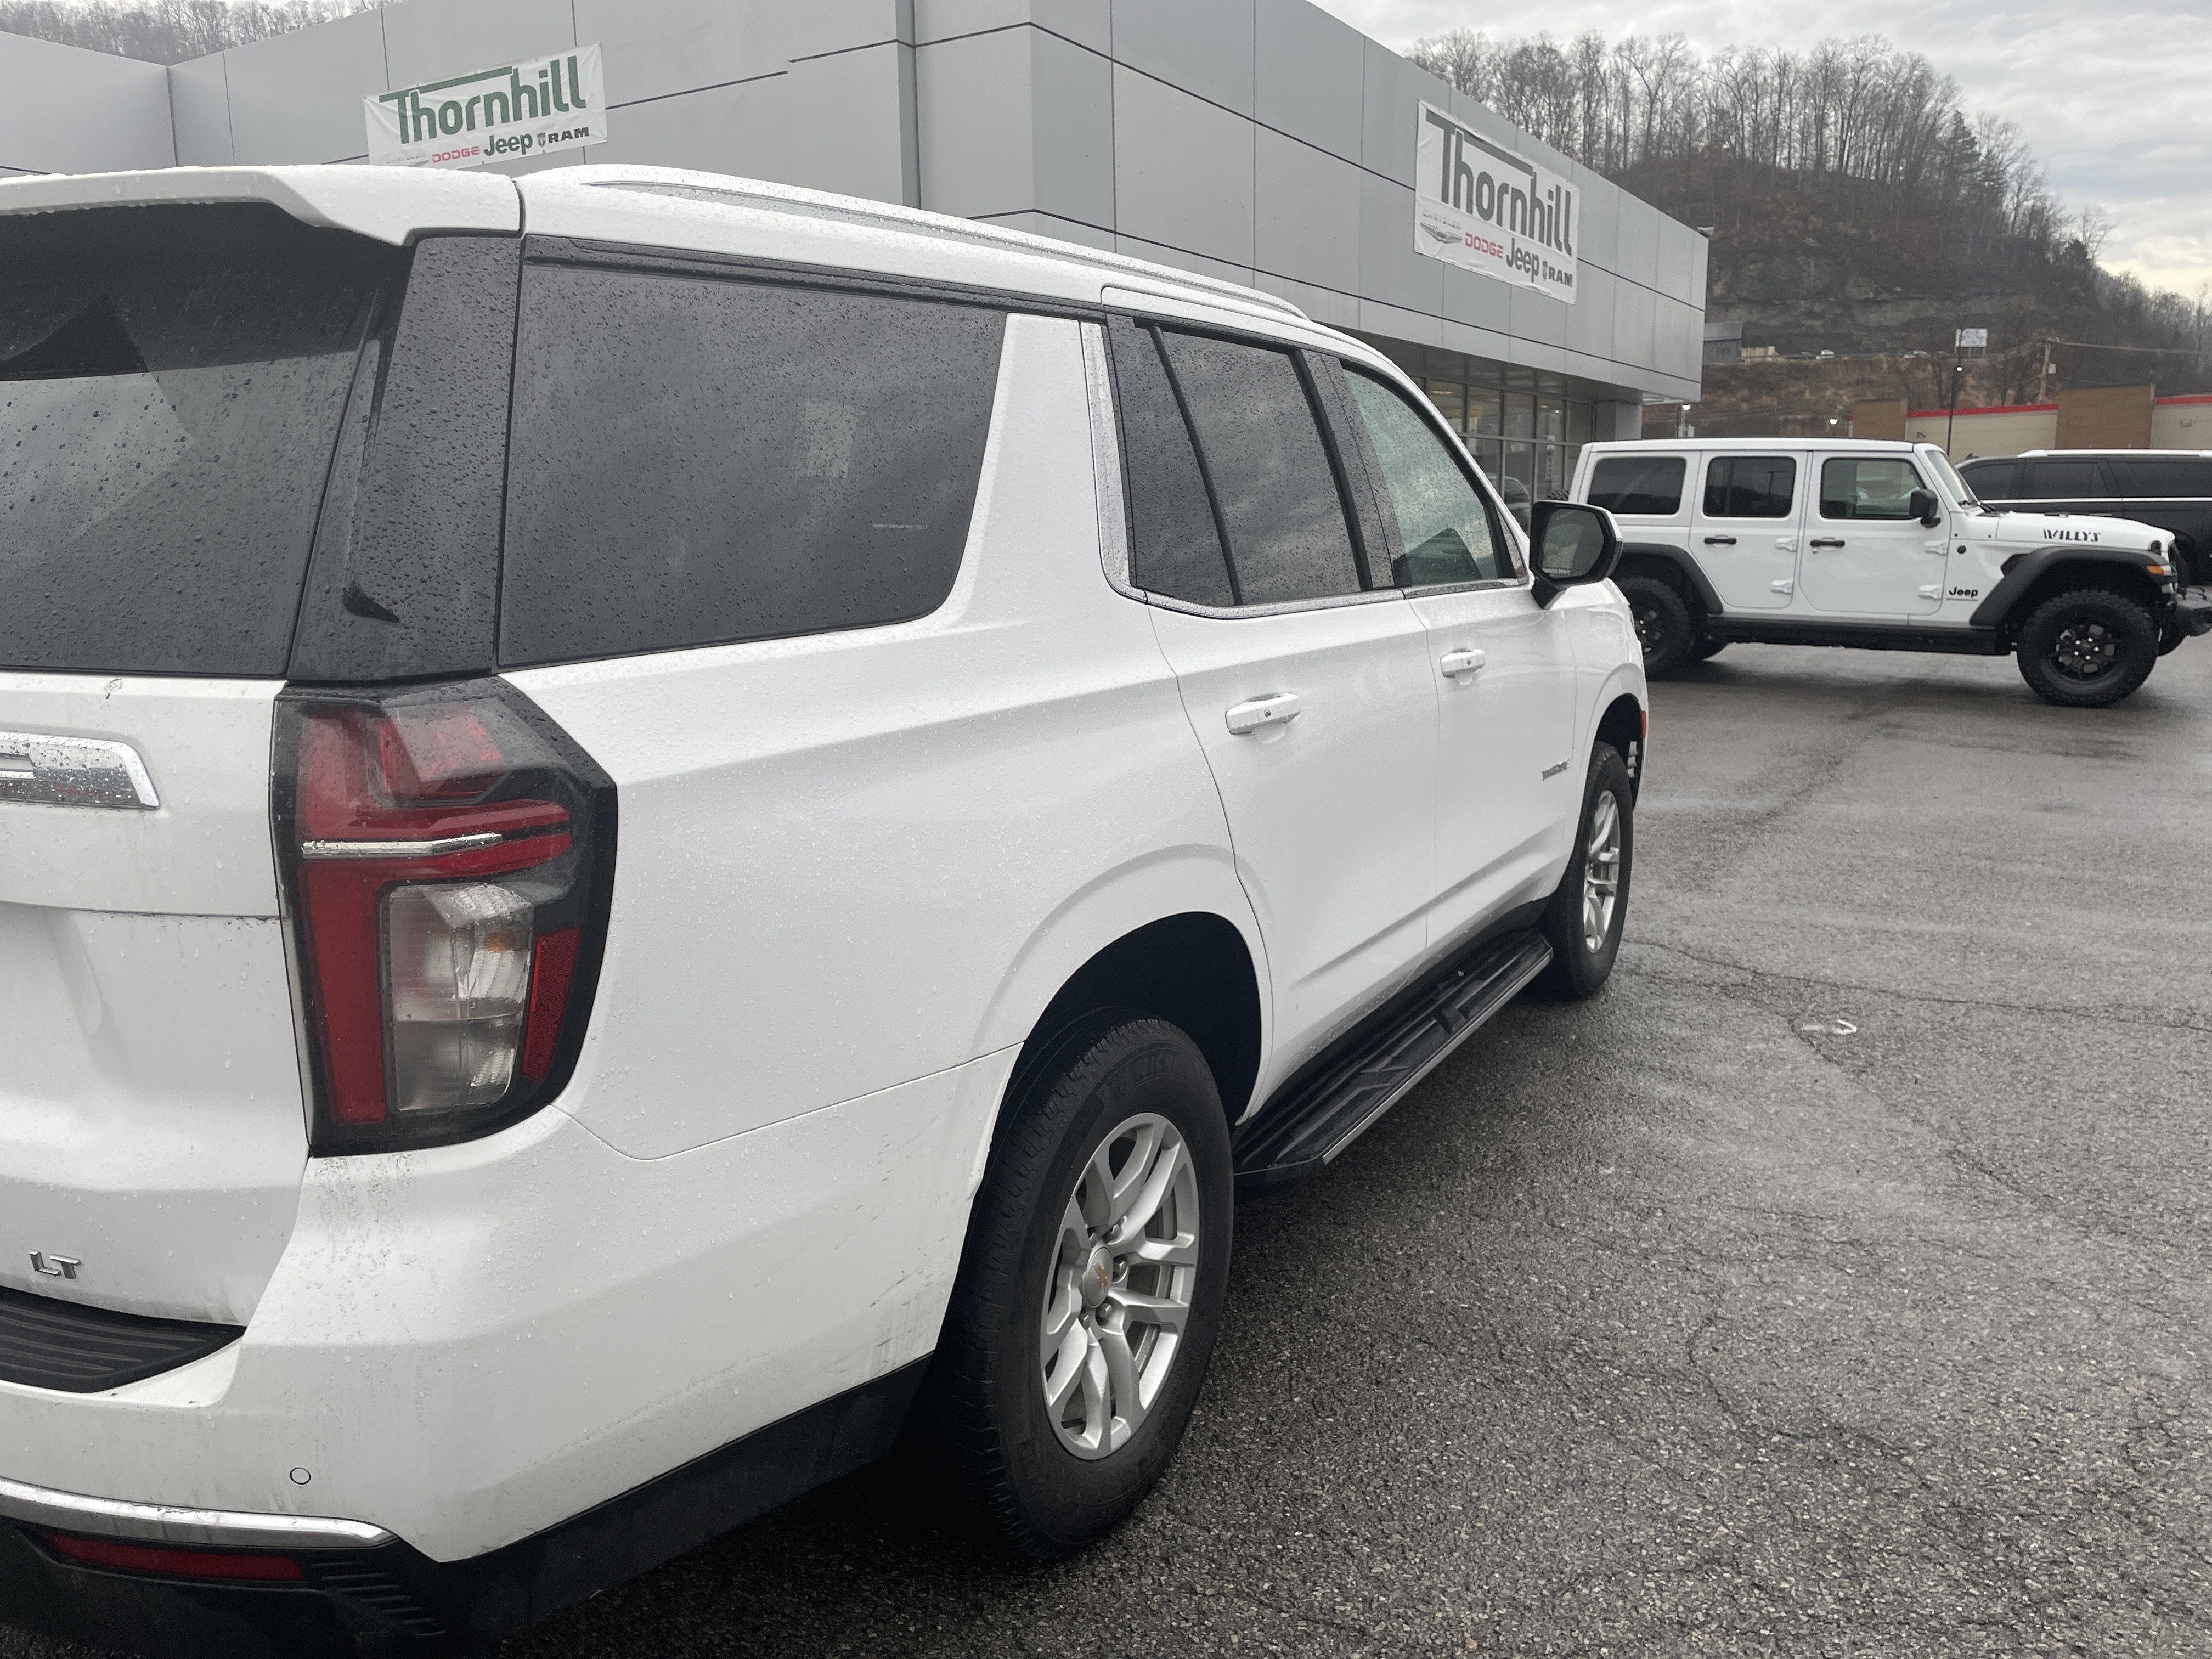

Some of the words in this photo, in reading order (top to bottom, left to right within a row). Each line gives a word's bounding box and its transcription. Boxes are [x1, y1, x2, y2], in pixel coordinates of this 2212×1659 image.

[379, 55, 587, 144] Thornhill
[432, 146, 480, 163] DODGE
[484, 133, 533, 156] Jeep
[548, 127, 589, 144] RAM
[1425, 109, 1572, 256] Thornhill
[1465, 232, 1504, 259] DODGE
[1506, 238, 1539, 283] Jeep
[1549, 267, 1573, 287] RAM
[2042, 528, 2101, 542] WILLYS
[1949, 586, 1978, 597] Jeep
[29, 1250, 81, 1279] LT
